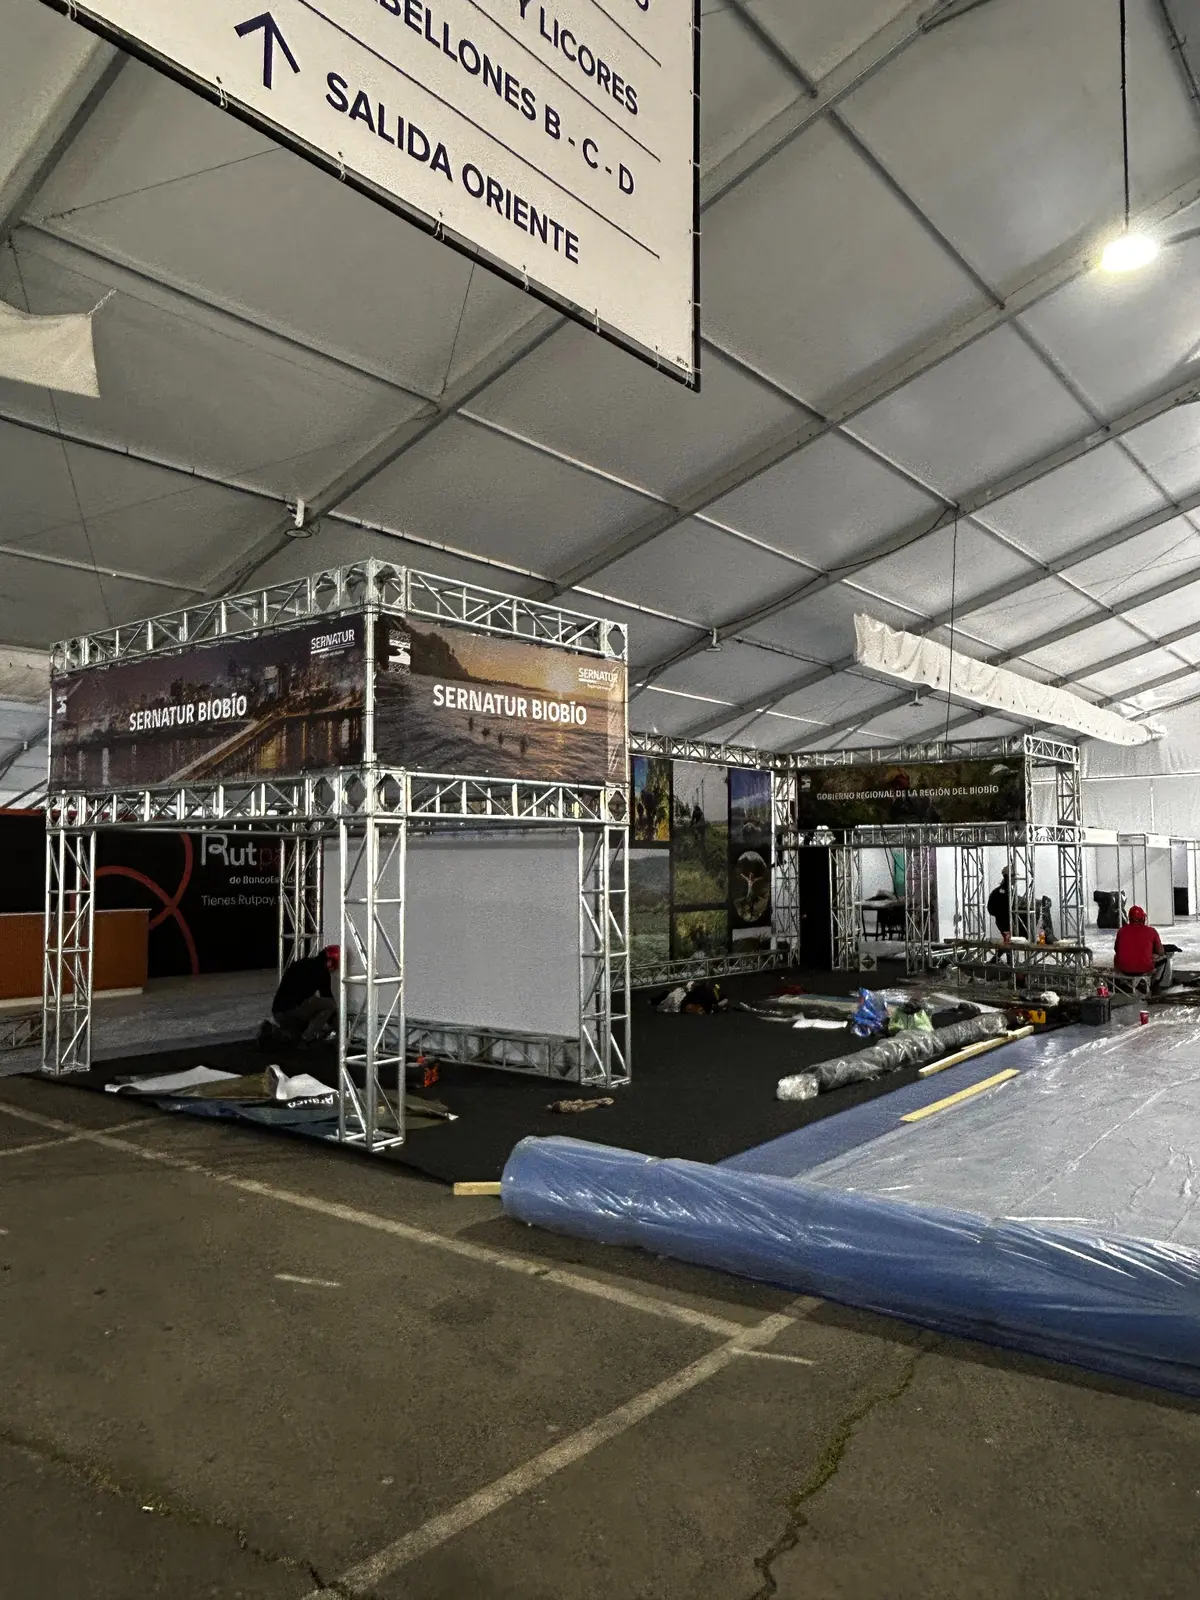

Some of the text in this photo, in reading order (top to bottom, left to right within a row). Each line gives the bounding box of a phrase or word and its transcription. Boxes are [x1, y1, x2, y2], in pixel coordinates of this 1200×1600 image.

[539, 6, 638, 115] LICORES
[325, 72, 579, 264] SALIDA ORIENTE
[545, 103, 560, 140] B
[582, 137, 598, 169] C
[619, 162, 634, 195] D
[311, 629, 355, 649] SERNATUR
[578, 667, 618, 683] SERNATUR
[129, 692, 248, 732] SERNATUR BIOBÍO
[433, 684, 587, 725] SERNATUR BIOBÍO
[816, 784, 999, 801] GOBIERNO REGIONAL DE LA REGIÓN DEL BIOBÍO
[201, 895, 236, 906] Tienes
